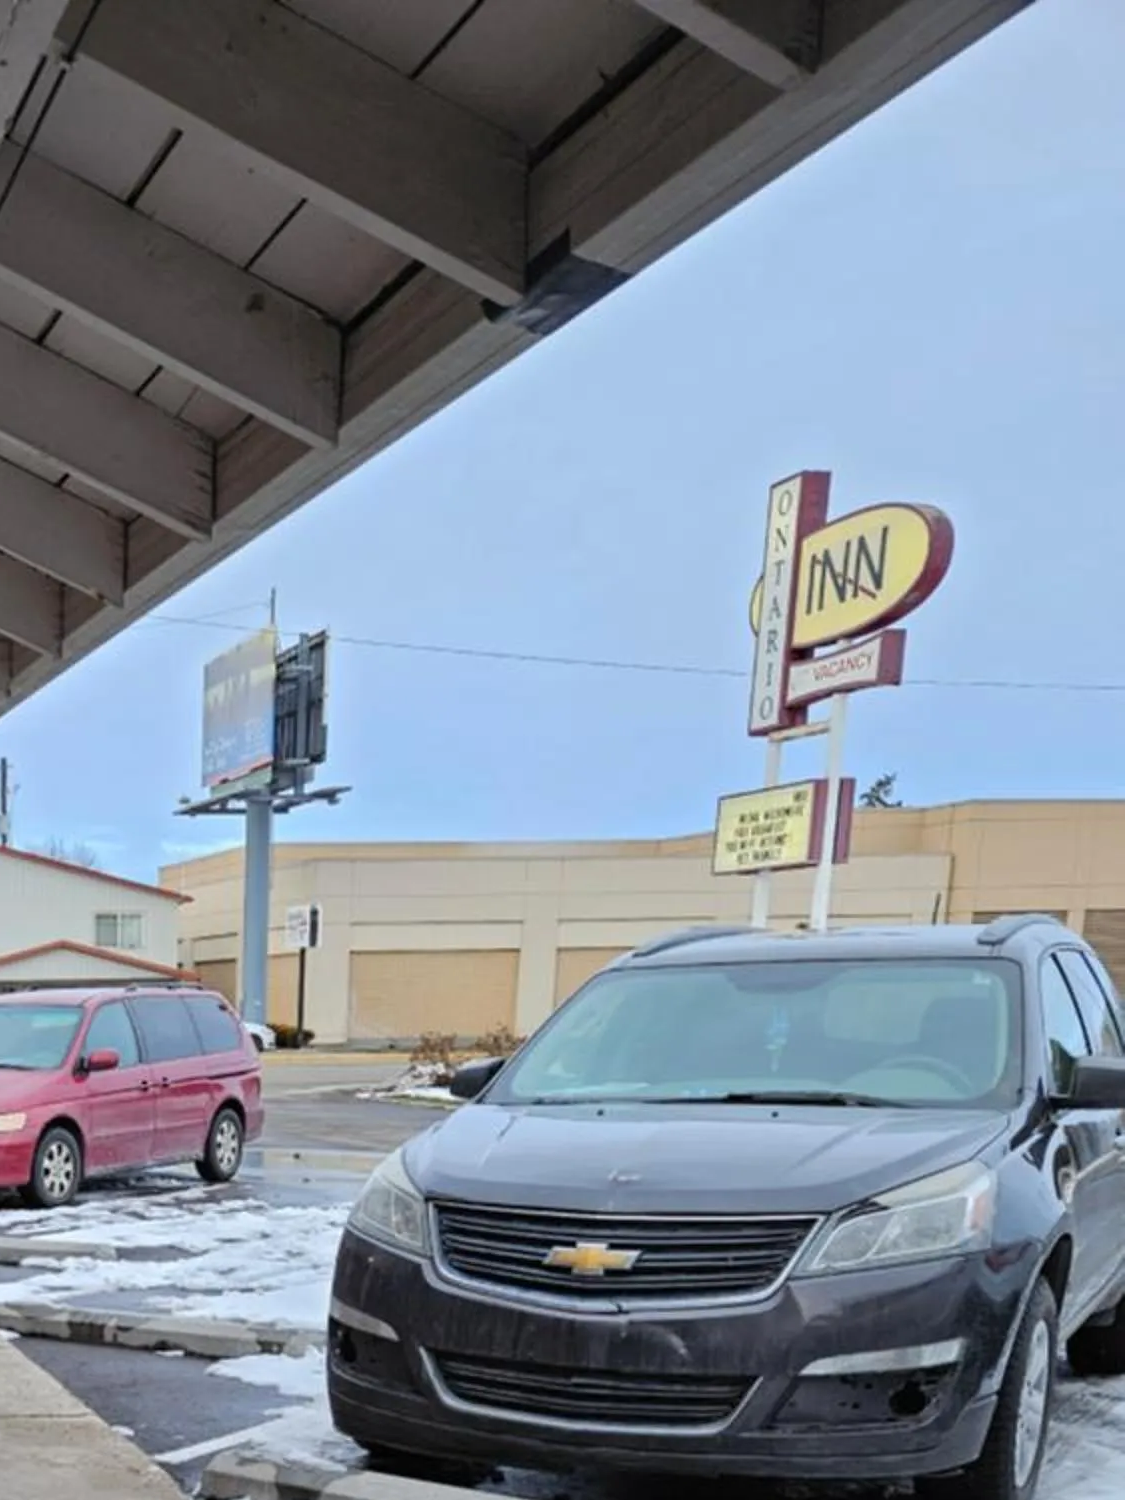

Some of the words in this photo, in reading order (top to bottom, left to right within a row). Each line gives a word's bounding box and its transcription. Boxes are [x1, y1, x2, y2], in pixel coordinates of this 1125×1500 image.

[760, 490, 793, 720] ONTARIO
[806, 525, 889, 615] INN
[813, 653, 874, 681] VACANCY
